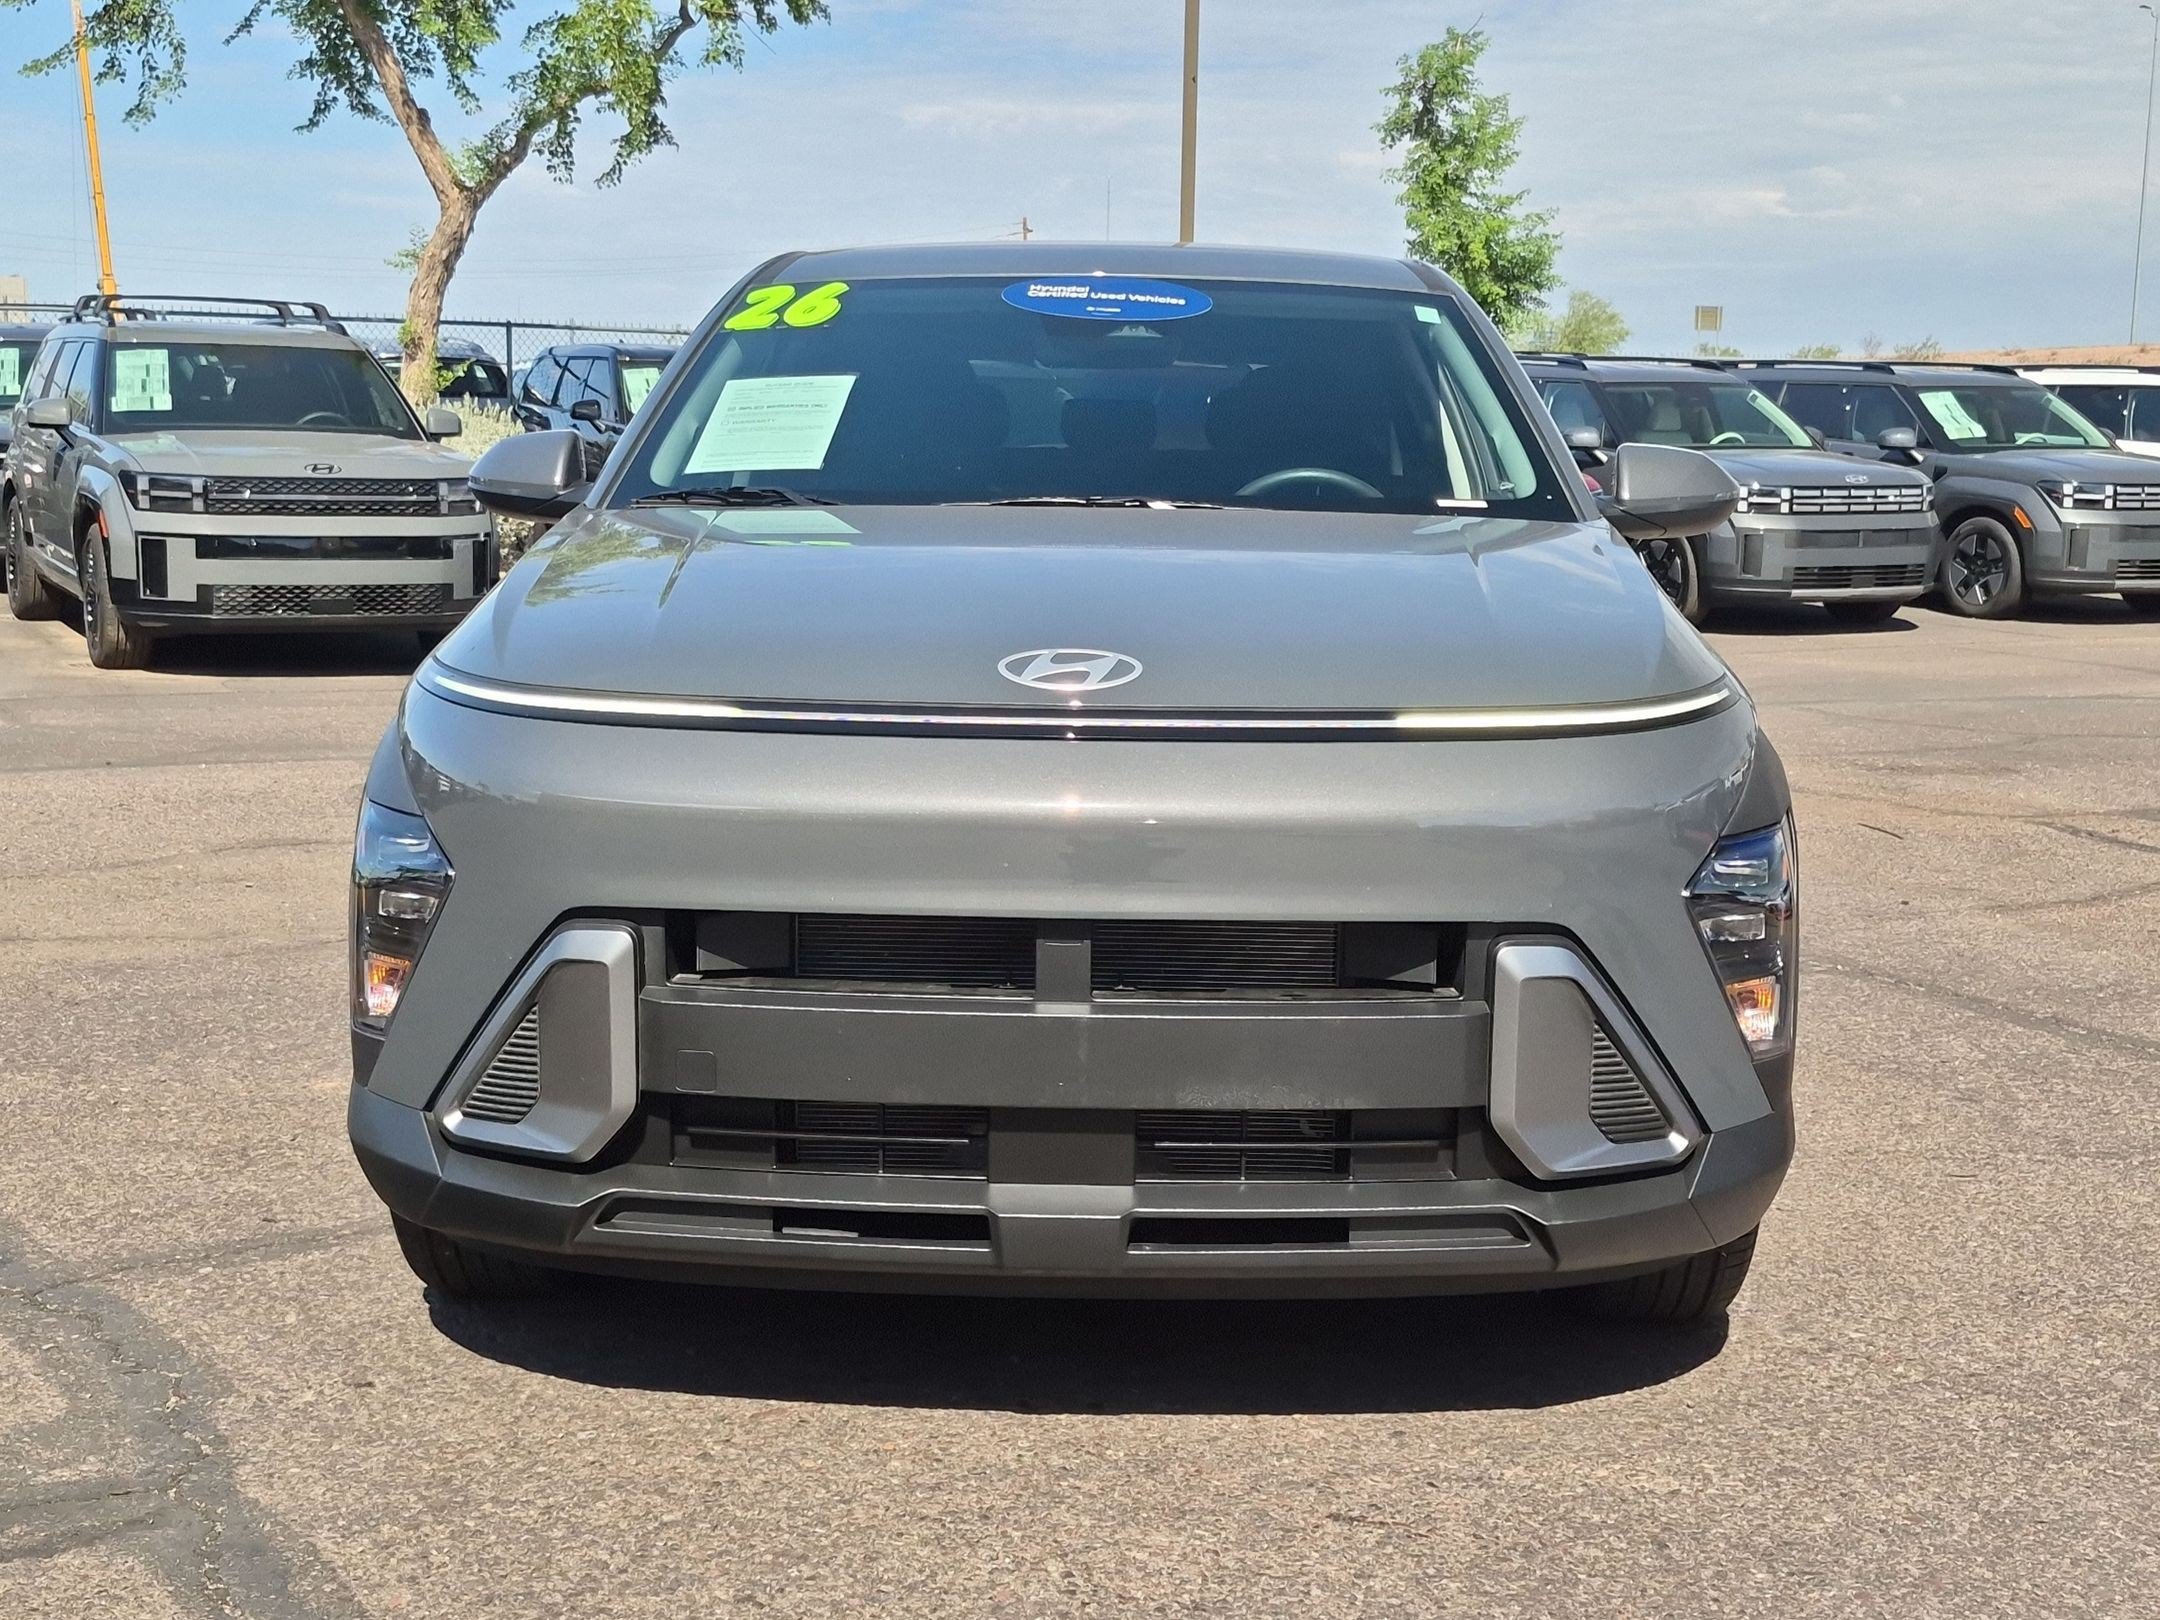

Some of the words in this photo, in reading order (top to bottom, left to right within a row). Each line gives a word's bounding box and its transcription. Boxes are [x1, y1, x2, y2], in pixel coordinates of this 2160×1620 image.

[1029, 284, 1090, 293] Hyundai
[1027, 290, 1089, 298] Certified
[1090, 292, 1126, 301] Used
[1128, 293, 1186, 305] Vehicles
[723, 281, 850, 331] 26
